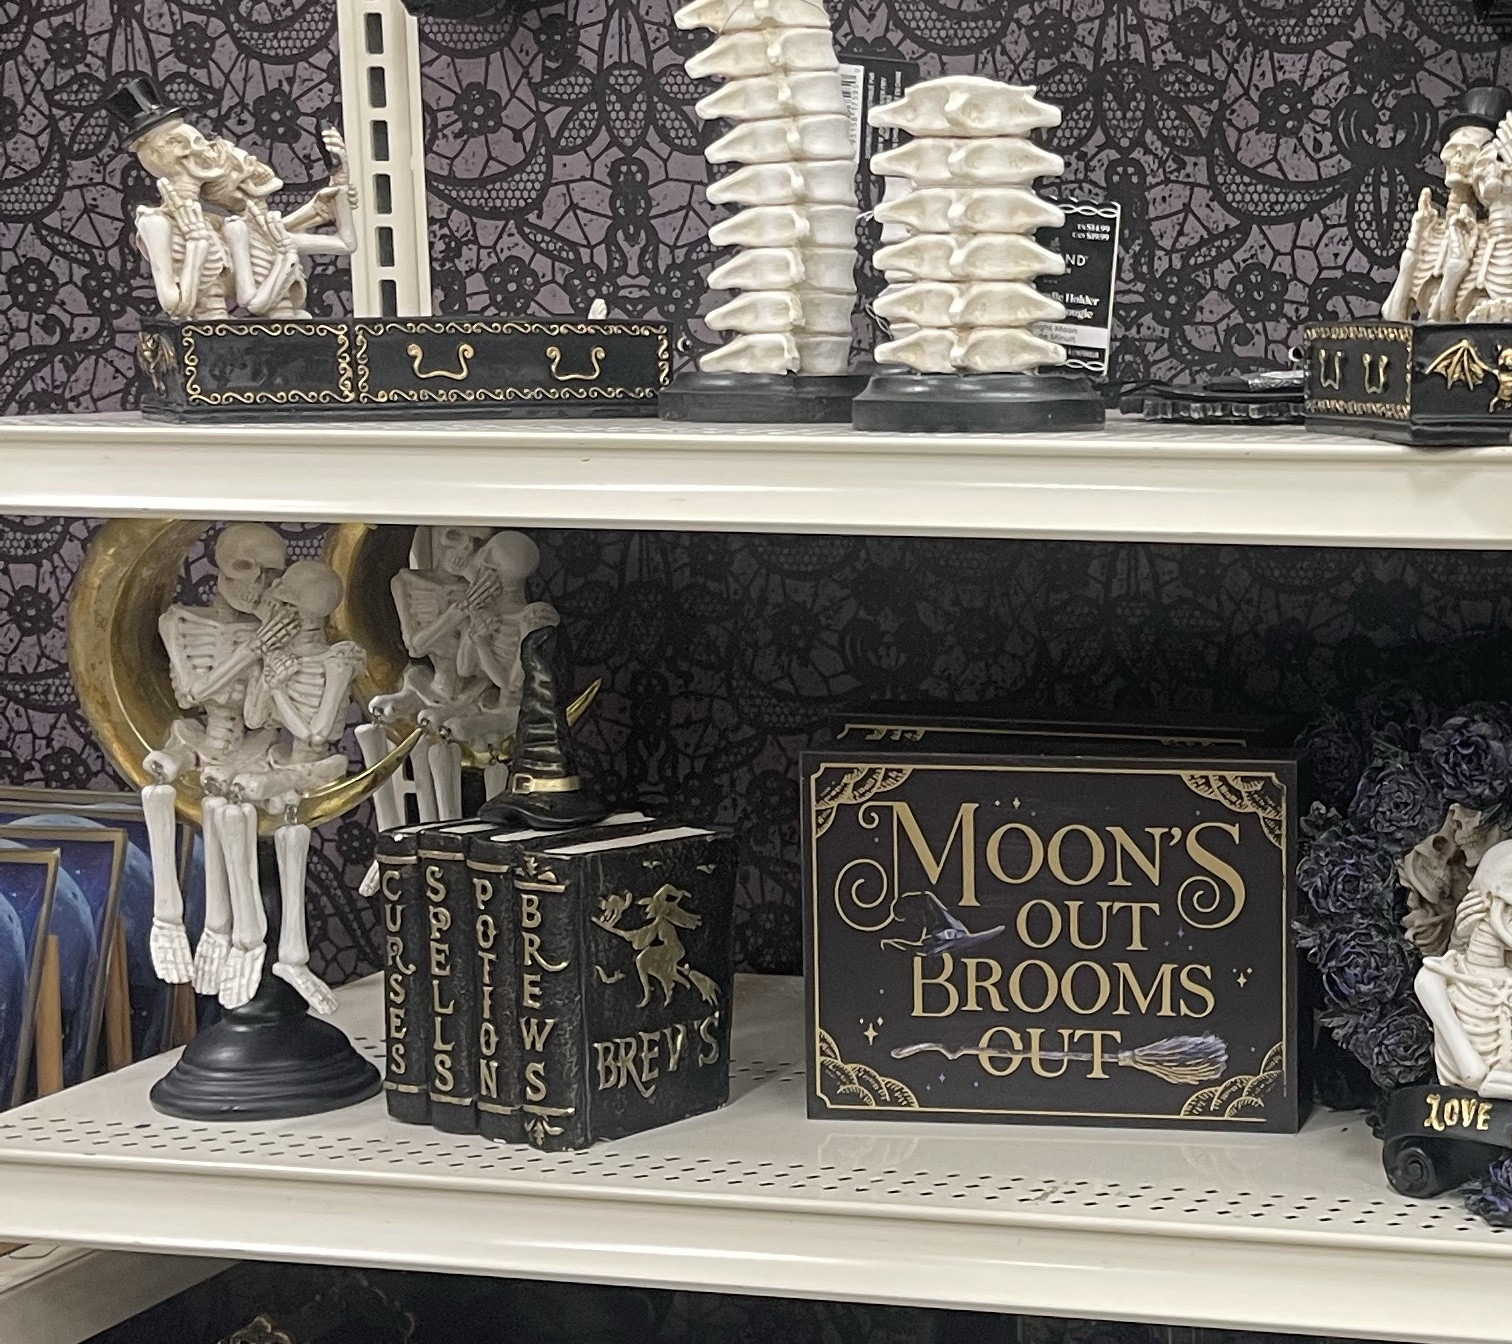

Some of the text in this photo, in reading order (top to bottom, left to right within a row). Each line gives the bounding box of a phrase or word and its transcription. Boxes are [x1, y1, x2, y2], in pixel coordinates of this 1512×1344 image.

[382, 870, 417, 1075] CURSES
[425, 865, 455, 1093] SPELLS
[472, 878, 499, 1099] POTION
[911, 952, 1216, 1019] BROOMS
[1015, 899, 1160, 951] OUT
[520, 893, 570, 1102] BREWS
[977, 1026, 1122, 1080] OUT
[1423, 1093, 1493, 1132] LOVE
